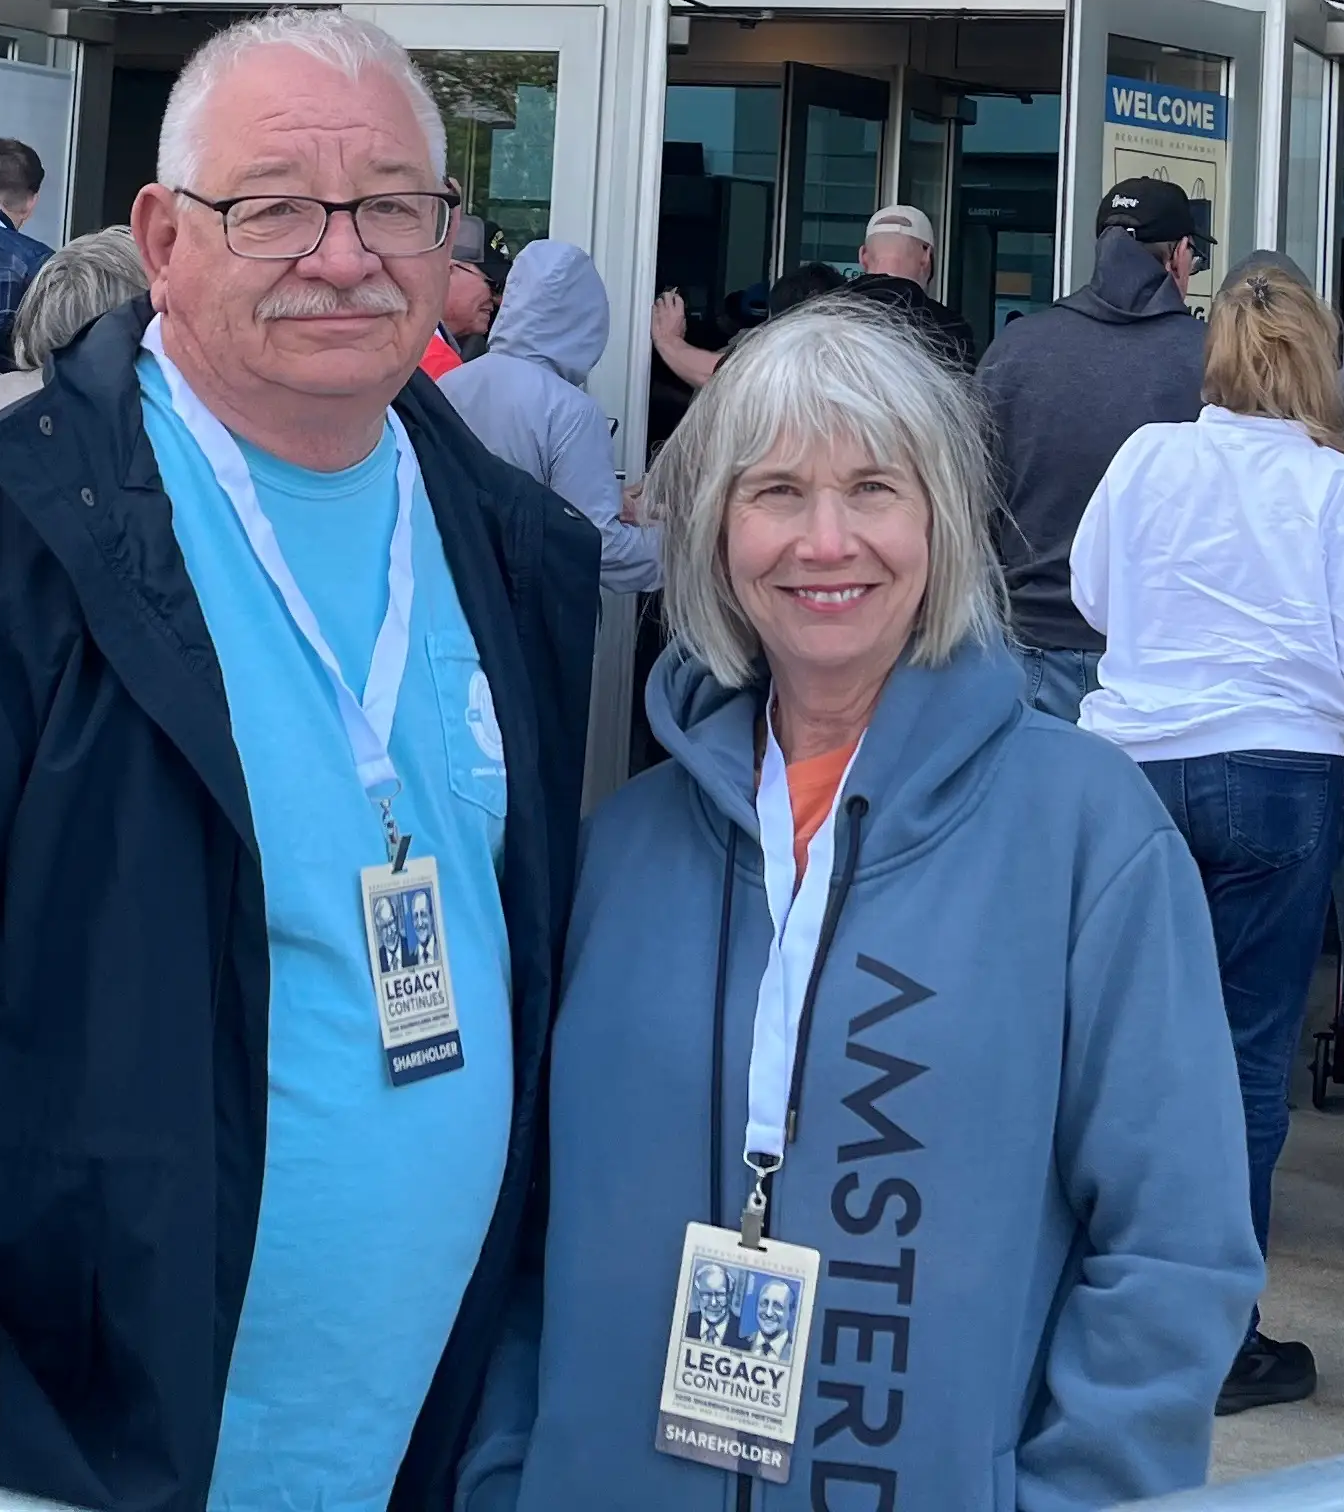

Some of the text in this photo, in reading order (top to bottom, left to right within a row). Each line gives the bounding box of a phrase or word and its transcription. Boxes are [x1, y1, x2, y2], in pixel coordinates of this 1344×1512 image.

[1112, 87, 1215, 130] WELCOME
[385, 970, 441, 1000] LEGACY
[388, 990, 445, 1017] CONTINUES
[393, 1040, 459, 1073] SHAREHOLDER
[684, 1348, 785, 1389] LEGACY
[681, 1370, 782, 1408] CONTINUES
[664, 1424, 783, 1468] SHAREHOLDER
